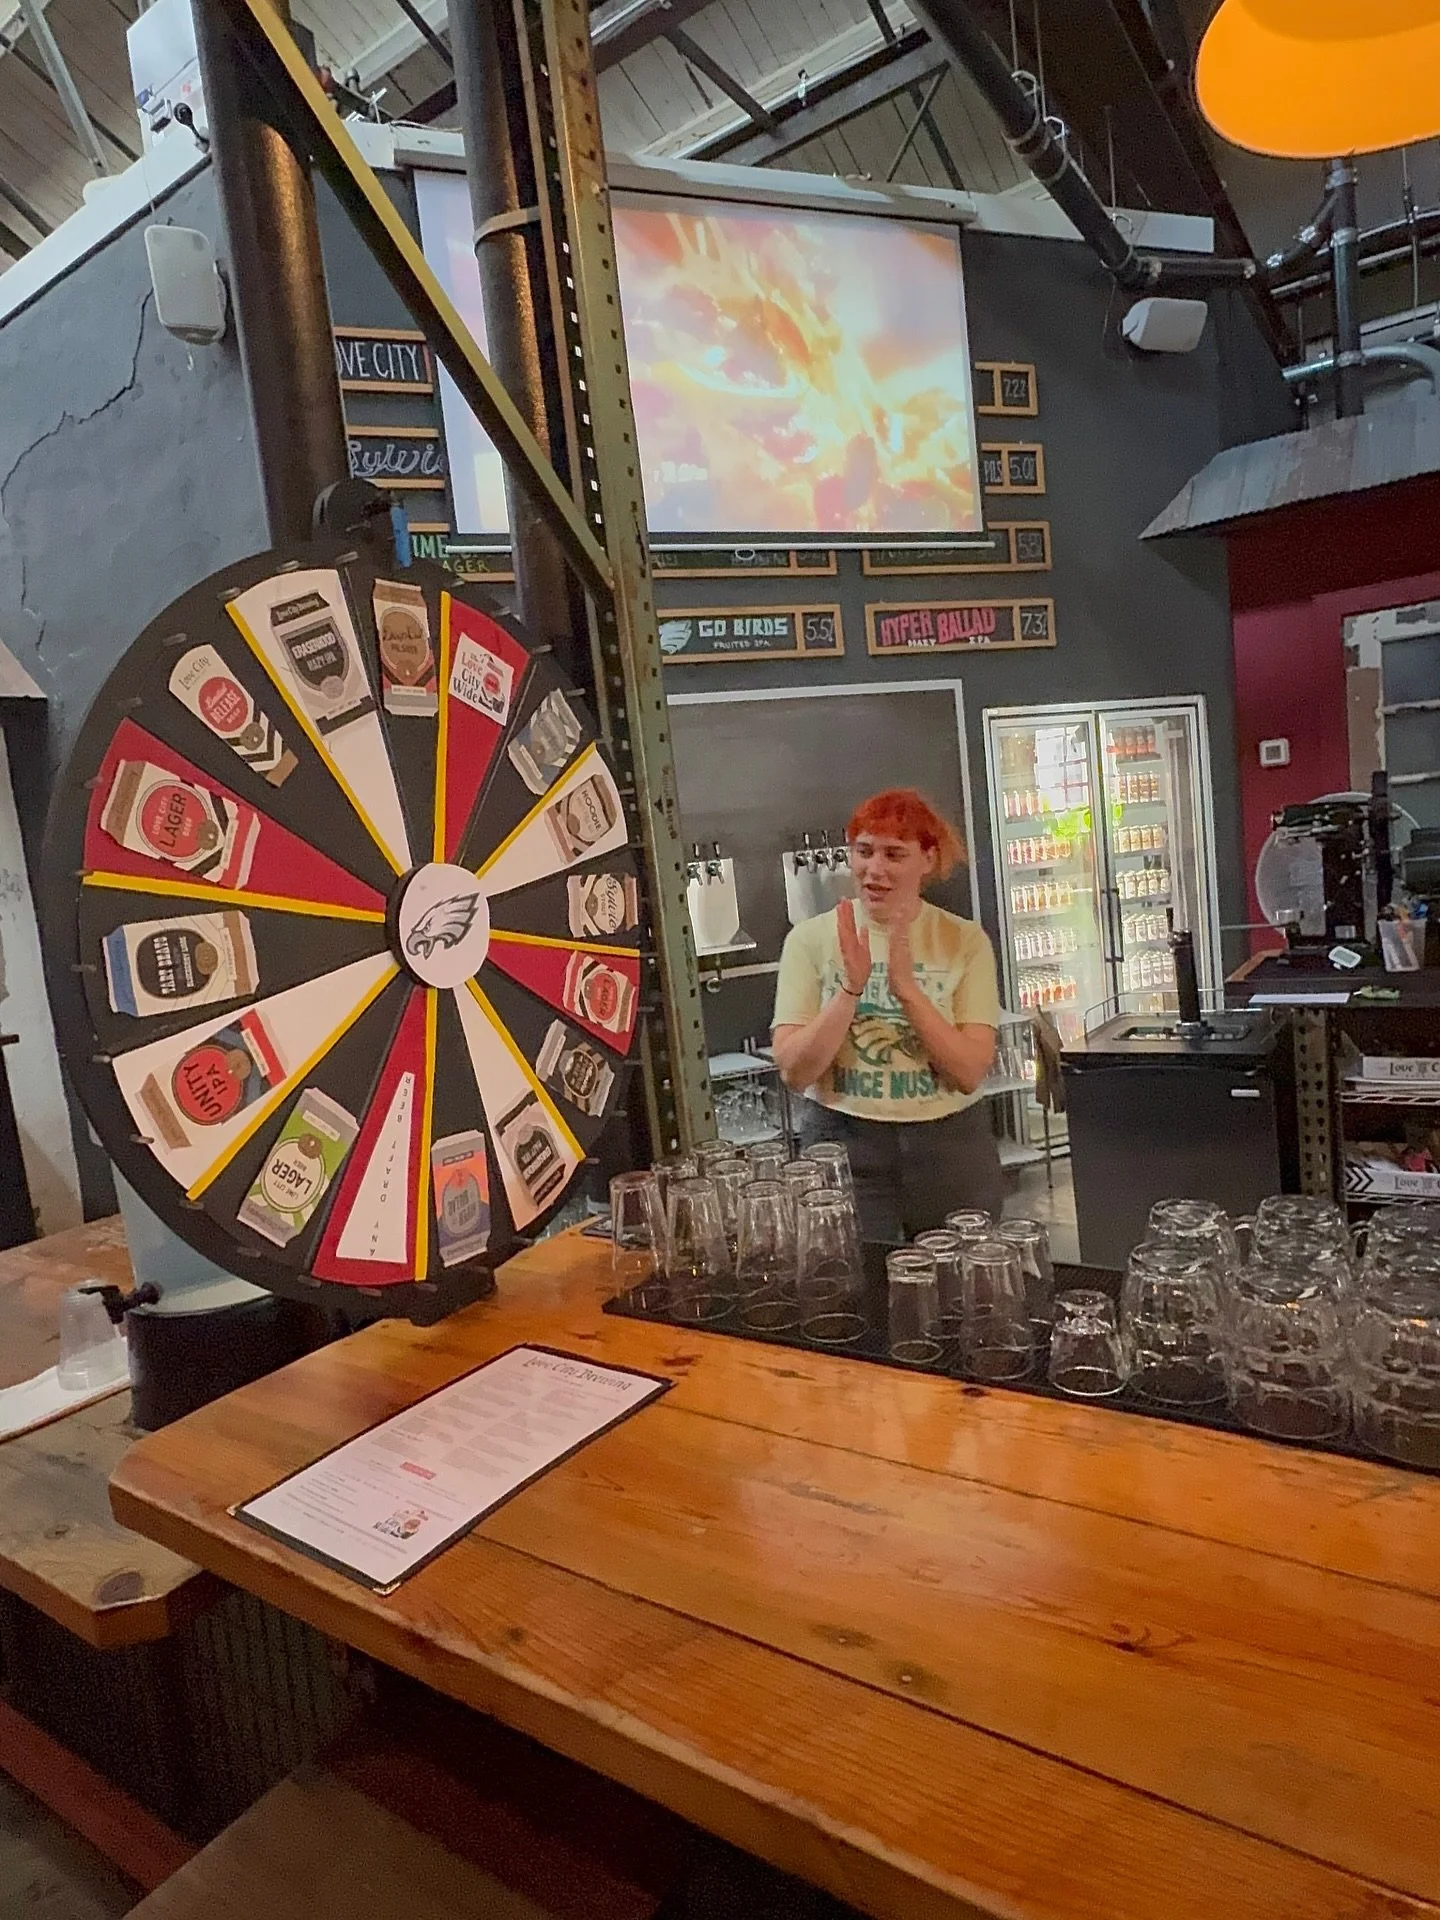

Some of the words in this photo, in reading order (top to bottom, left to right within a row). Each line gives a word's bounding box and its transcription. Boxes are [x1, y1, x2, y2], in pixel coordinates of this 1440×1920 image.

[372, 343, 419, 380] CITY
[698, 619, 726, 637] GO
[733, 618, 788, 636] BIRDS
[881, 609, 934, 647] HYPER
[936, 607, 996, 644] BALLAD
[968, 636, 991, 645] IPA
[178, 671, 195, 691] Love
[192, 655, 211, 673] City
[461, 652, 483, 677] Love
[461, 668, 481, 691] City
[453, 676, 478, 704] Wide
[210, 689, 241, 724] RELEASE
[160, 792, 187, 848] LAGER
[581, 789, 602, 829] HOODIE
[158, 968, 176, 995] TART
[206, 1063, 228, 1095] IPA
[1389, 1062, 1414, 1076] Love
[183, 1062, 222, 1117] UNITY
[271, 1158, 313, 1195] LAGER
[1394, 1175, 1418, 1190] Love
